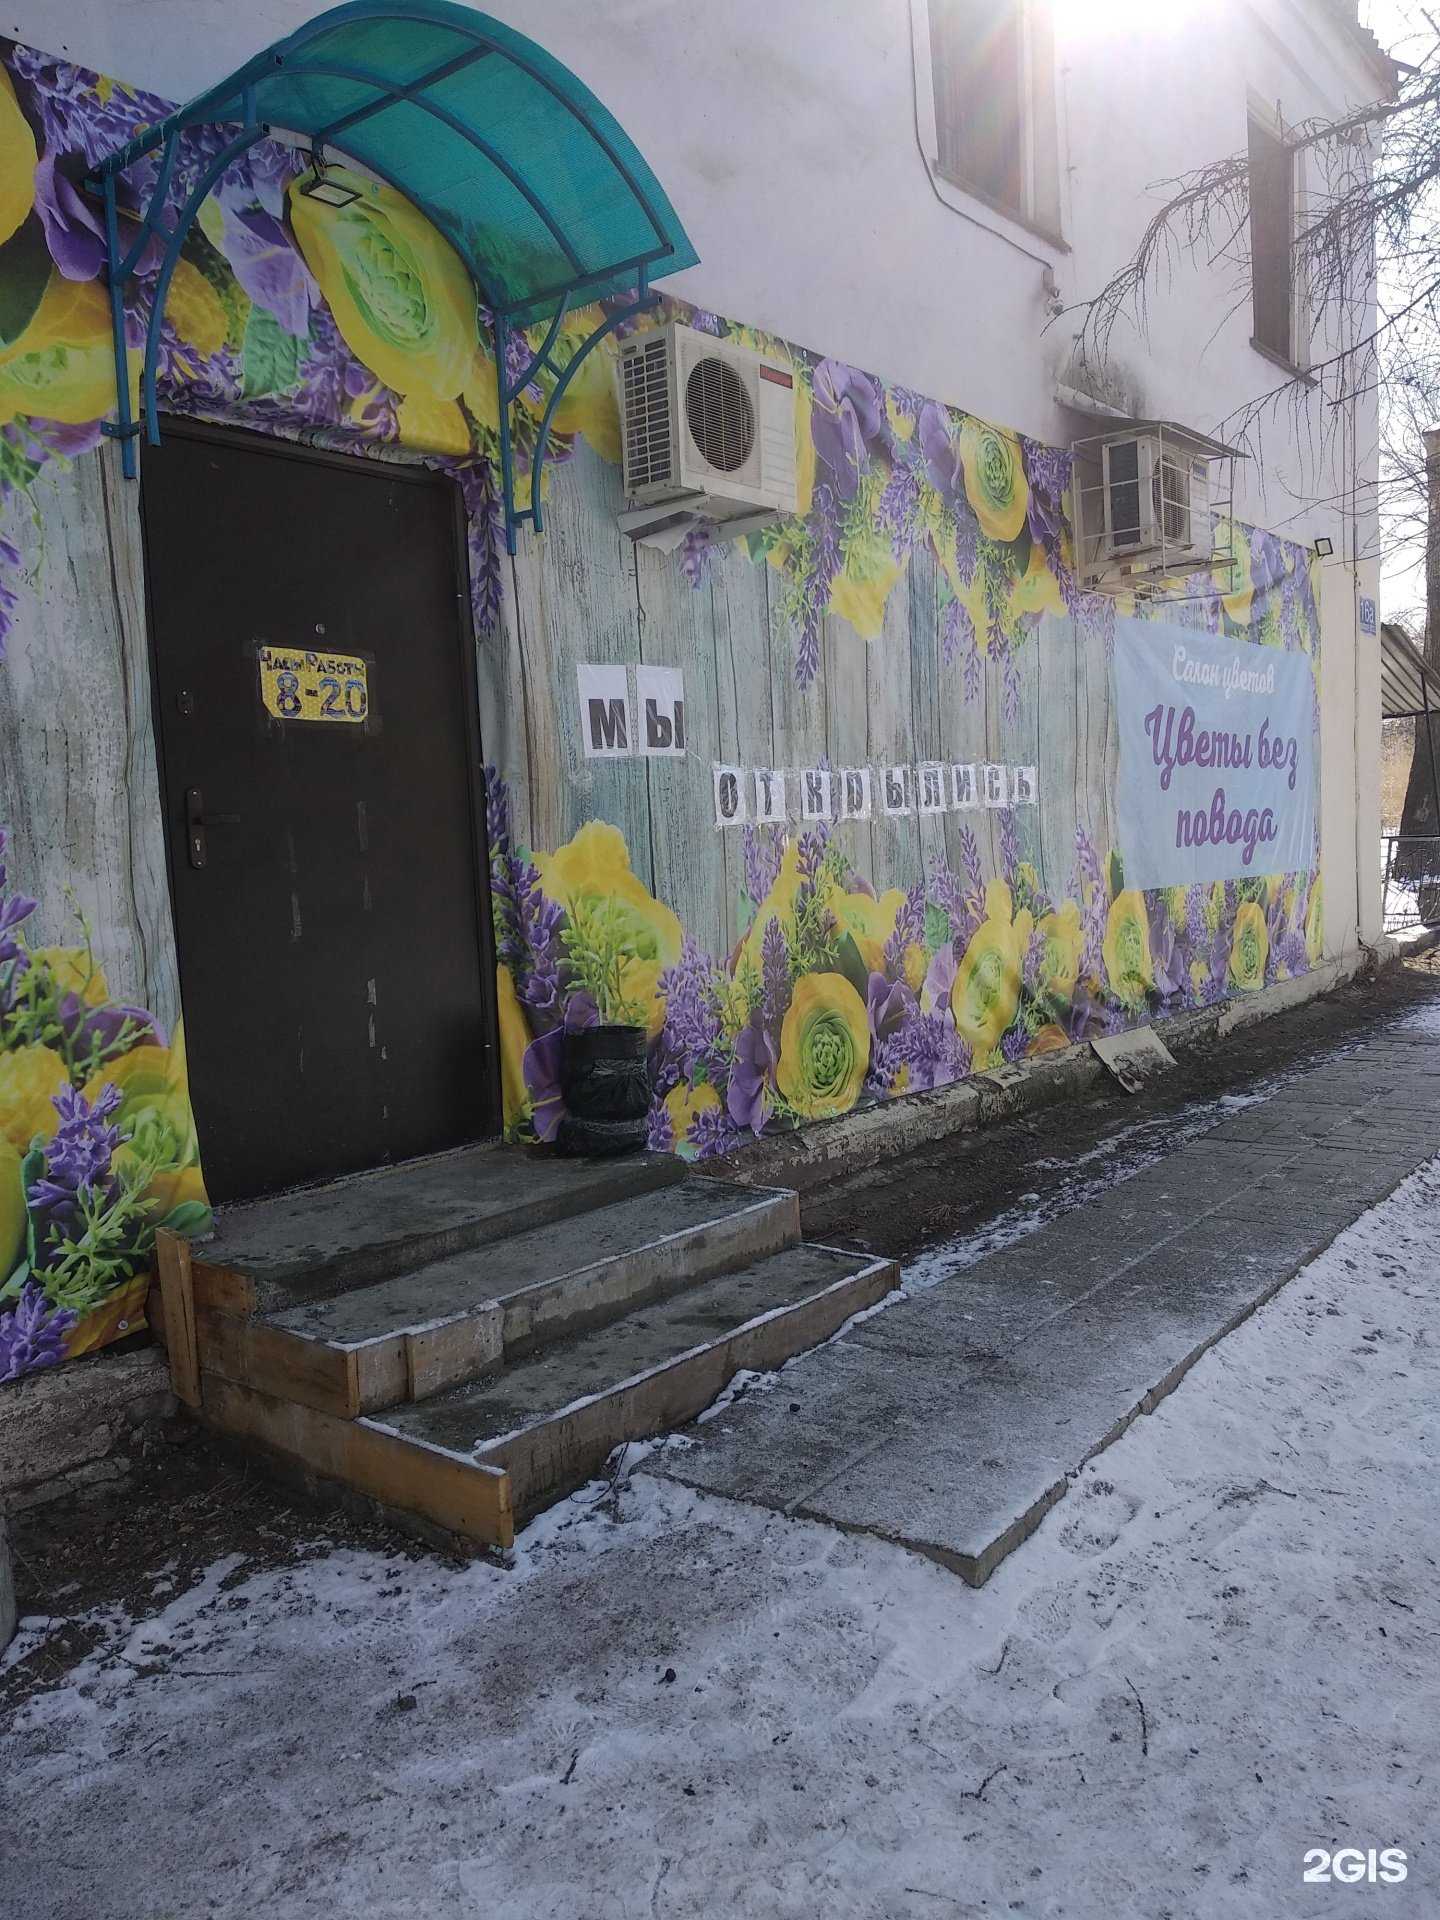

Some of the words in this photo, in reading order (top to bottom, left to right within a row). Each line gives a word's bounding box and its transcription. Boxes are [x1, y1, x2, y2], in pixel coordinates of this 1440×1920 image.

[276, 671, 367, 718] 8-20
[1171, 645, 1220, 686] Салон
[1222, 656, 1275, 698] цветов
[588, 698, 685, 749] МЫ
[1144, 703, 1252, 790] Цветы
[1257, 716, 1298, 790] без
[719, 767, 1031, 818] ОТКРЫЛИСЬ
[1175, 787, 1277, 866] повода
